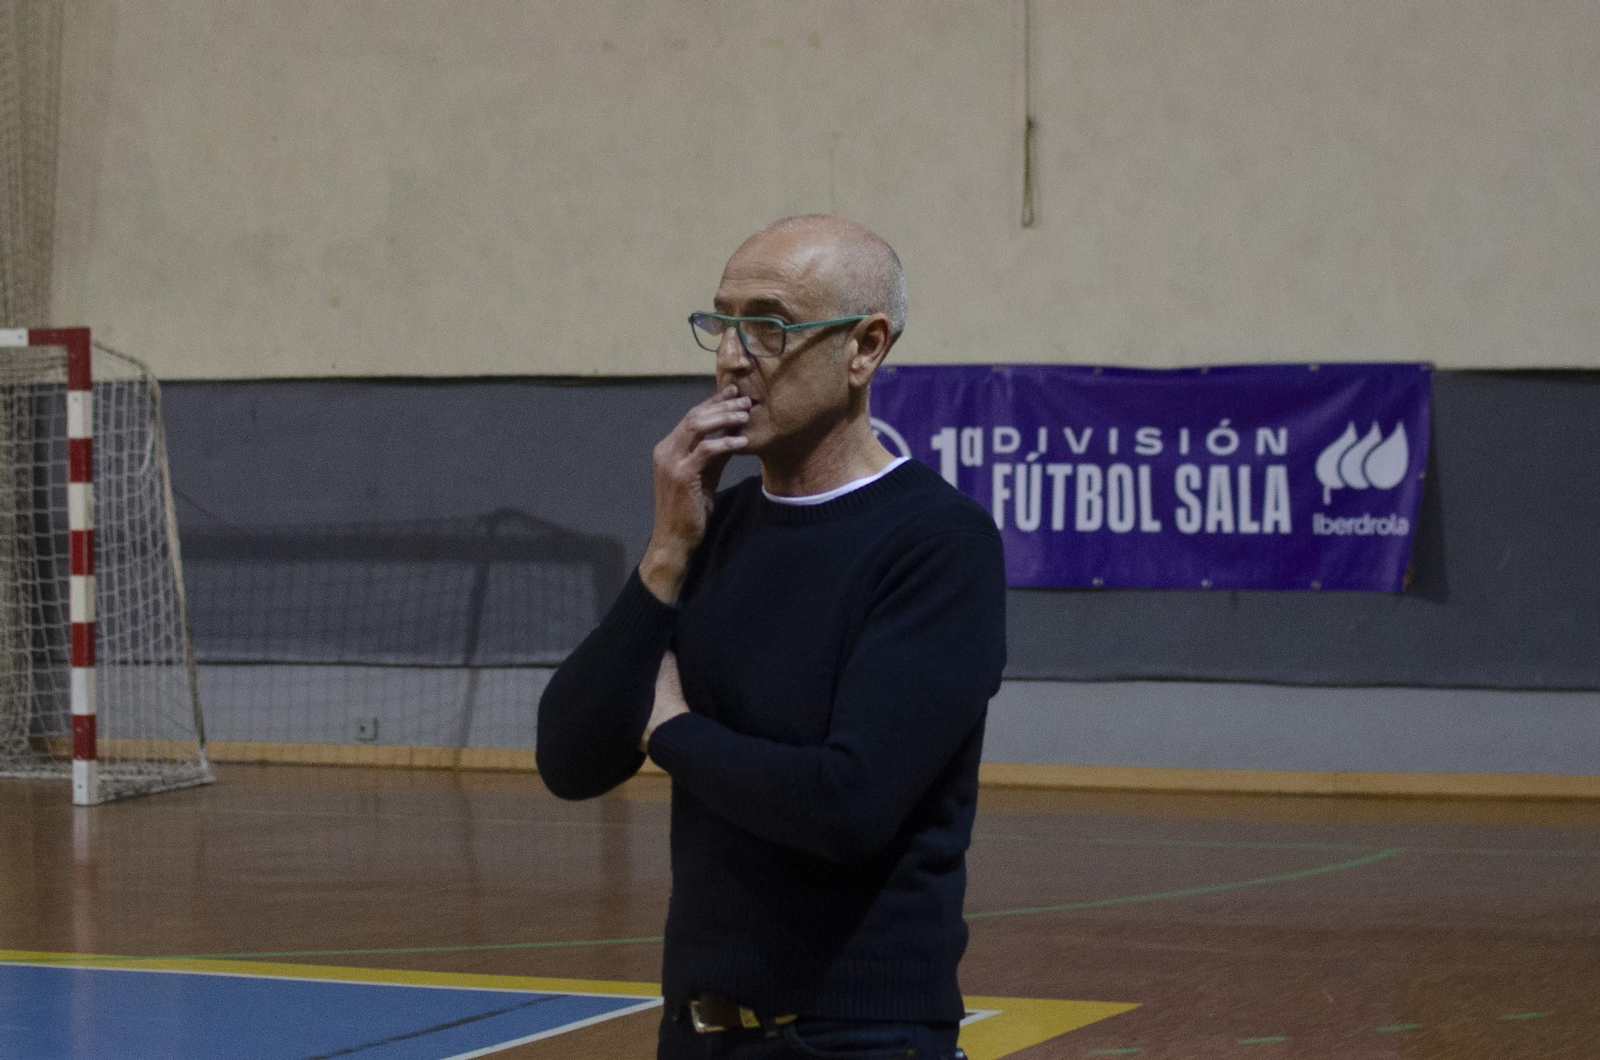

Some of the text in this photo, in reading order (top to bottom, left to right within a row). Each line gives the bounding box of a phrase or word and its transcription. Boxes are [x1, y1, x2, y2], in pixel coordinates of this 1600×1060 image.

[992, 418, 1290, 454] DIVISIÓN
[992, 452, 1293, 534] FÚTBOL SALA
[1312, 512, 1410, 536] Iberdrola
